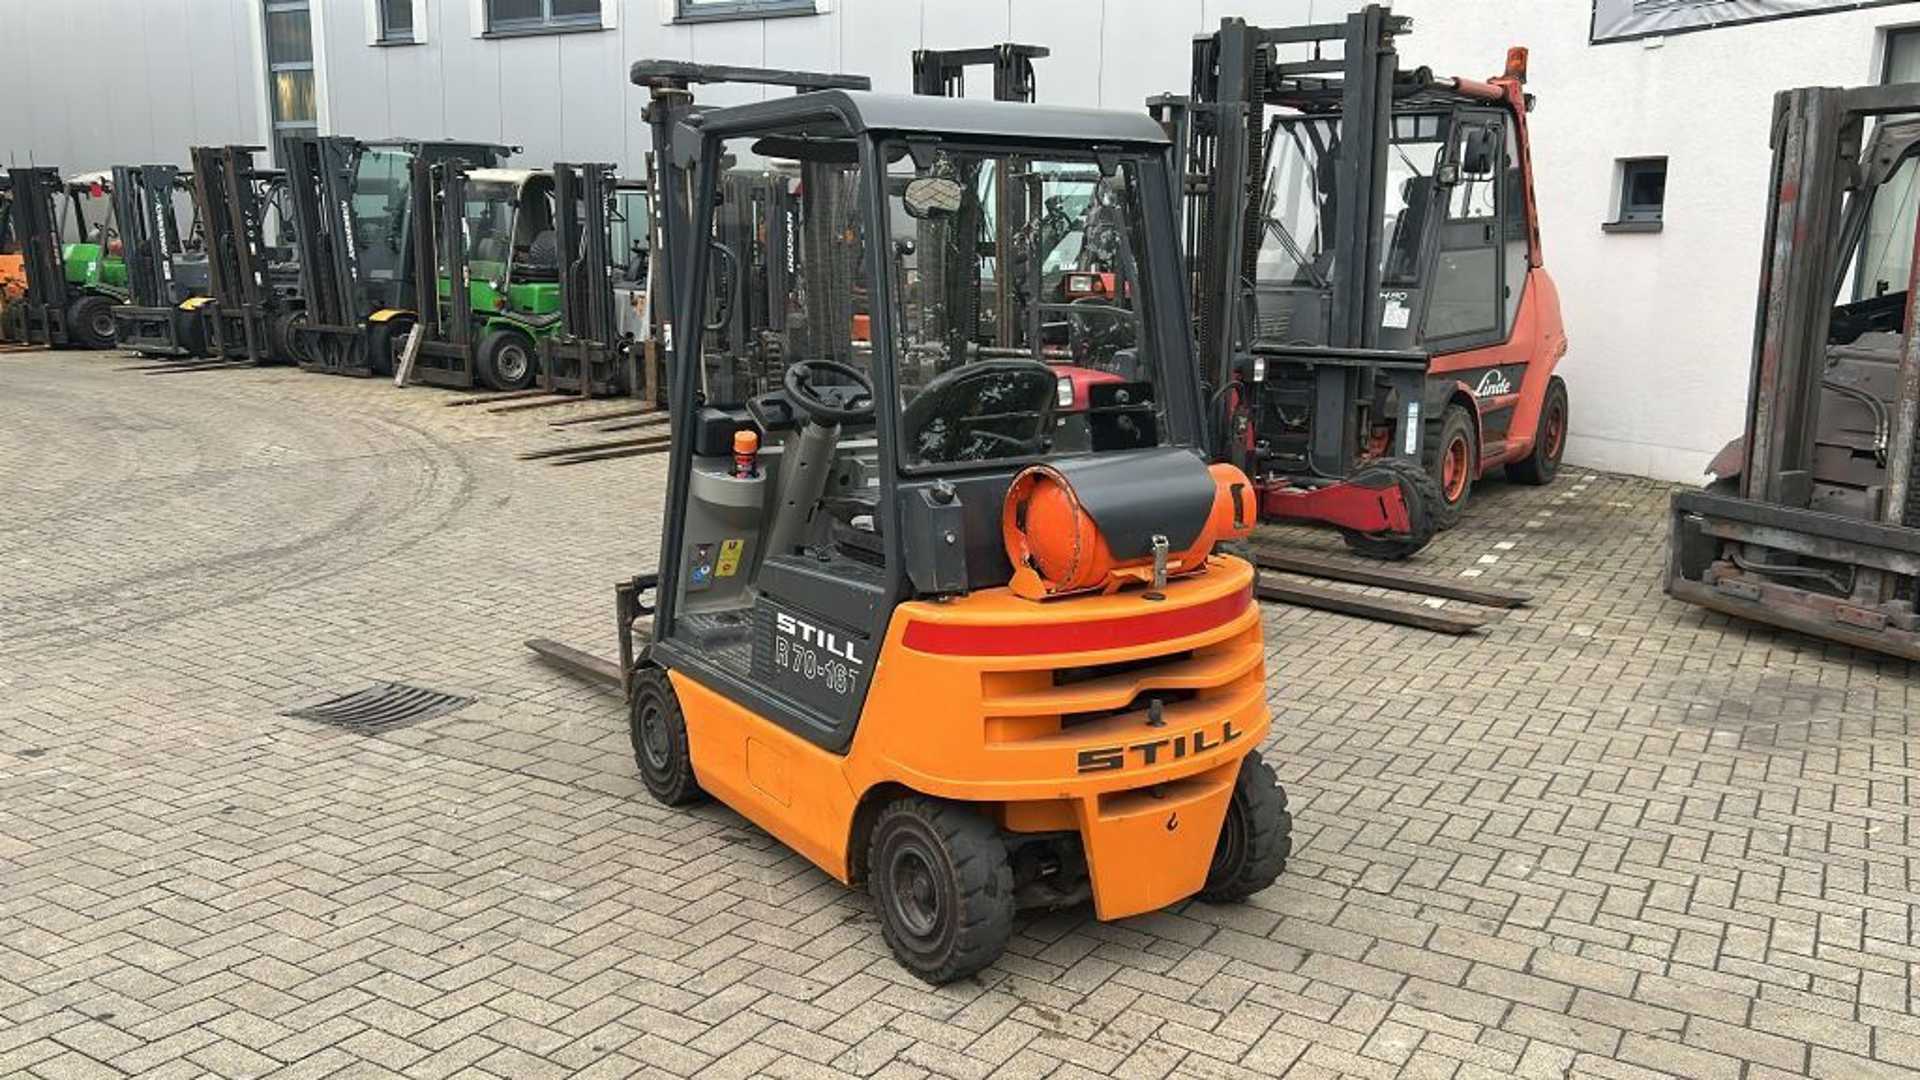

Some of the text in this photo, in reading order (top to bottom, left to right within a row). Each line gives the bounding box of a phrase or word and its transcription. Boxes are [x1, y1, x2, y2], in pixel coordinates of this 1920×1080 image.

[786, 211, 795, 273] DOOSAN
[1474, 368, 1512, 398] Linde
[776, 612, 863, 665] STILL
[1077, 719, 1243, 774] STILL
